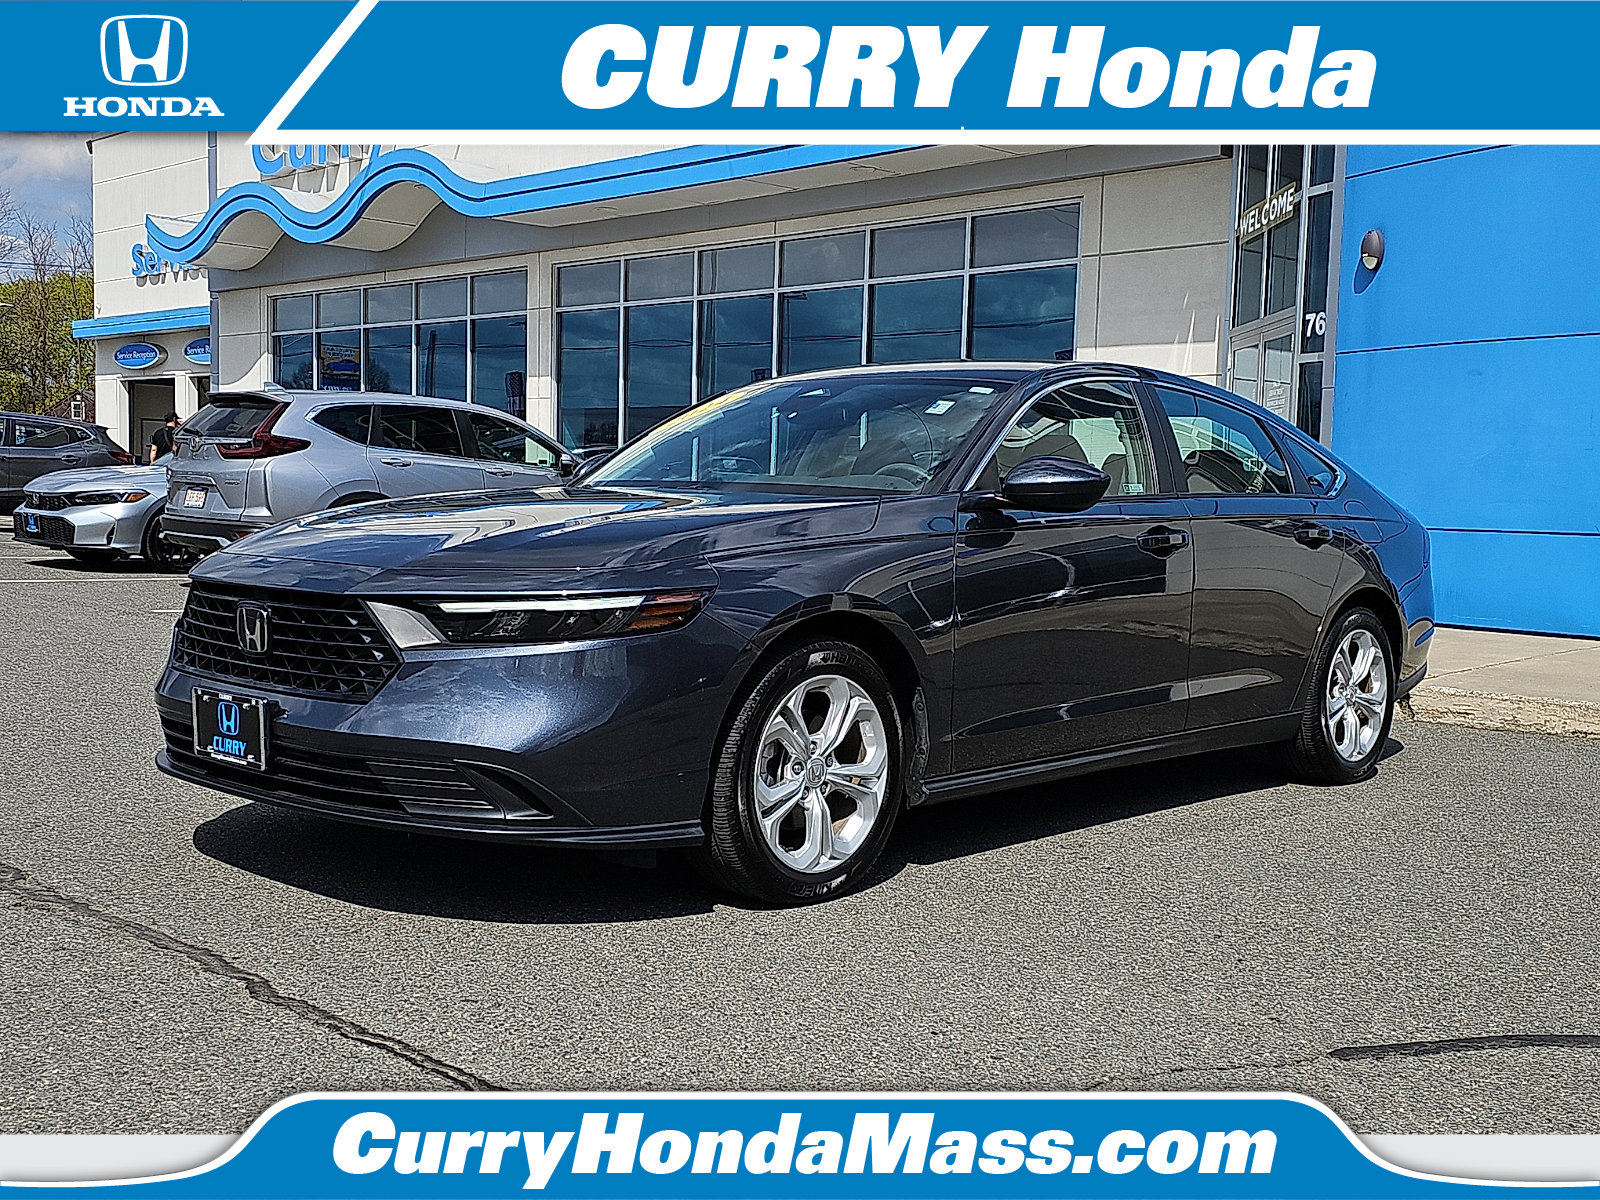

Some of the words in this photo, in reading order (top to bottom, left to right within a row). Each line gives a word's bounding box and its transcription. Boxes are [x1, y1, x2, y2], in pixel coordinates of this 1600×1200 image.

[252, 144, 382, 175] Cur
[1239, 187, 1296, 238] WELCOME
[1305, 311, 1327, 338] 76
[116, 351, 133, 361] Service
[132, 349, 156, 361] Reception
[186, 345, 206, 355] Service
[212, 735, 247, 757] CURRY
